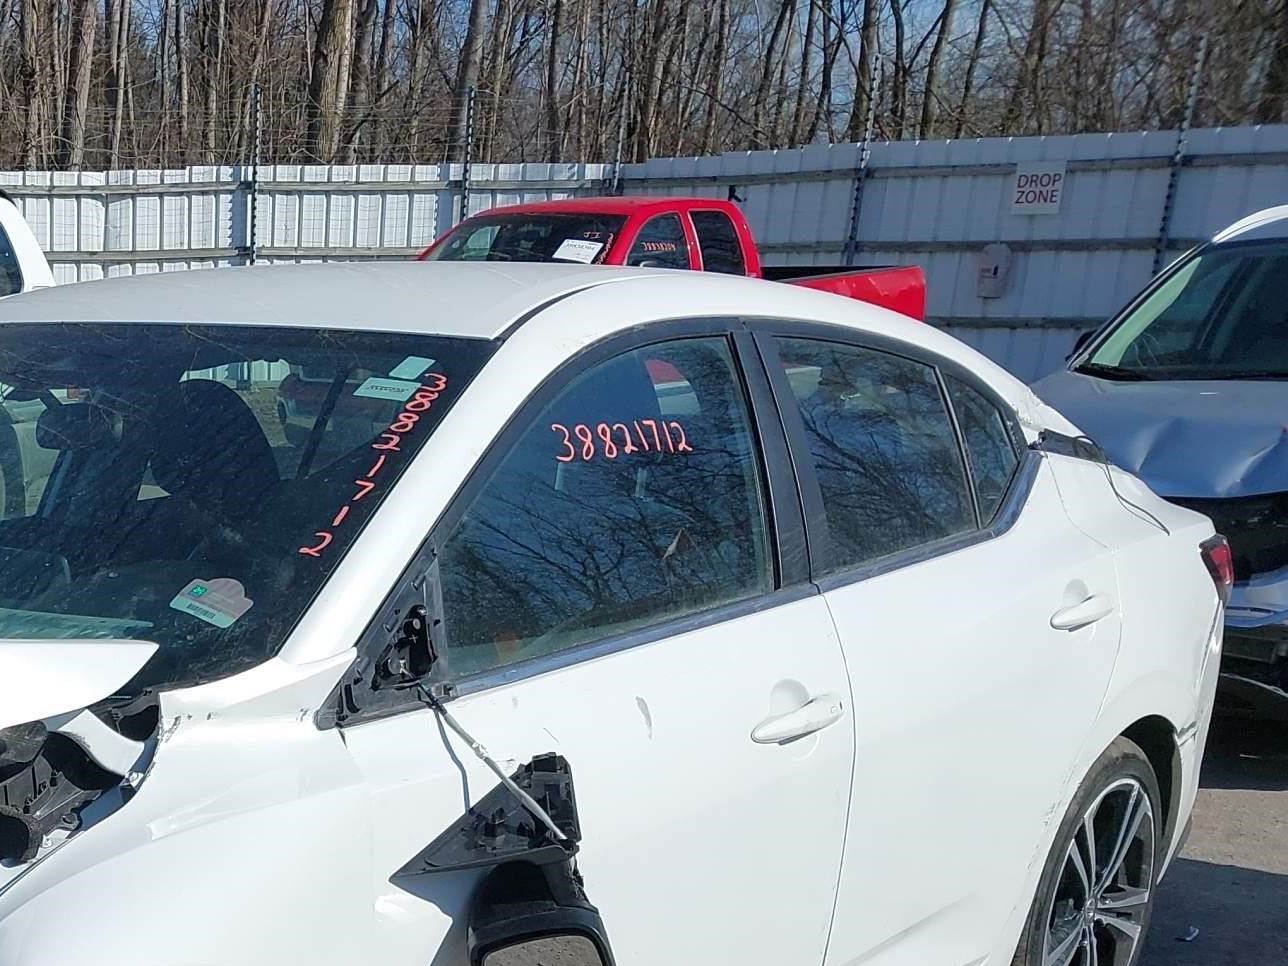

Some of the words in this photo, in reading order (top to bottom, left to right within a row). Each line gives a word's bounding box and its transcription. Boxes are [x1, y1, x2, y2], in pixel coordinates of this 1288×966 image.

[1017, 173, 1062, 189] DROP
[1014, 190, 1058, 204] ZONE
[551, 419, 694, 462] 38821712
[298, 372, 449, 557] 38821712
